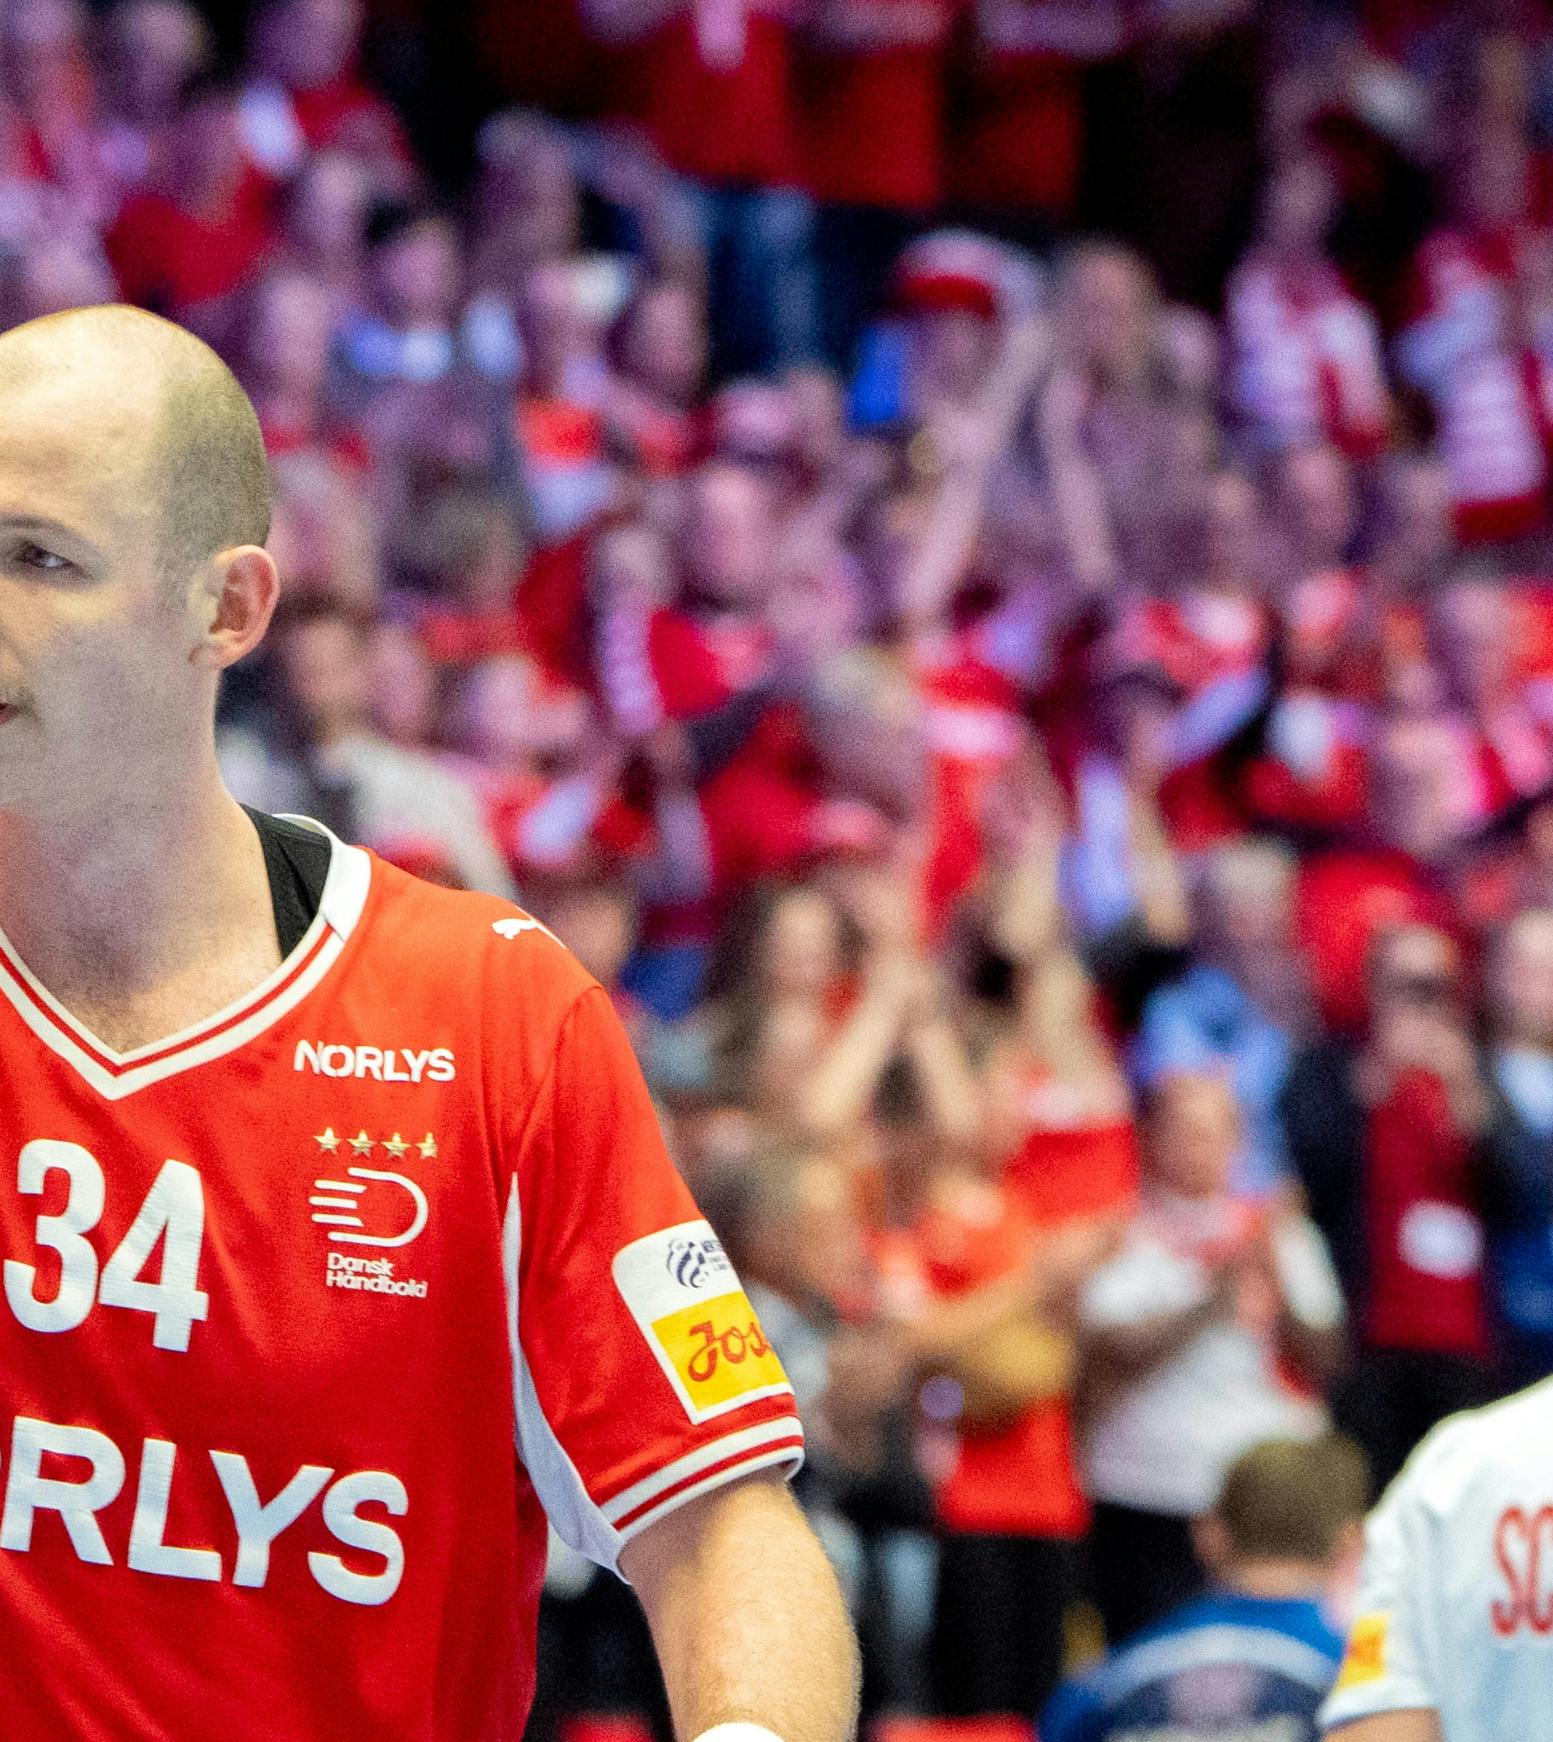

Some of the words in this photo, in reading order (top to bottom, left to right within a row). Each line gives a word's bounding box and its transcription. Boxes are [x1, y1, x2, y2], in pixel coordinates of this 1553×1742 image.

[294, 1040, 456, 1082] NORLYS
[3, 1138, 209, 1351] 34
[327, 1252, 394, 1275] Dansk
